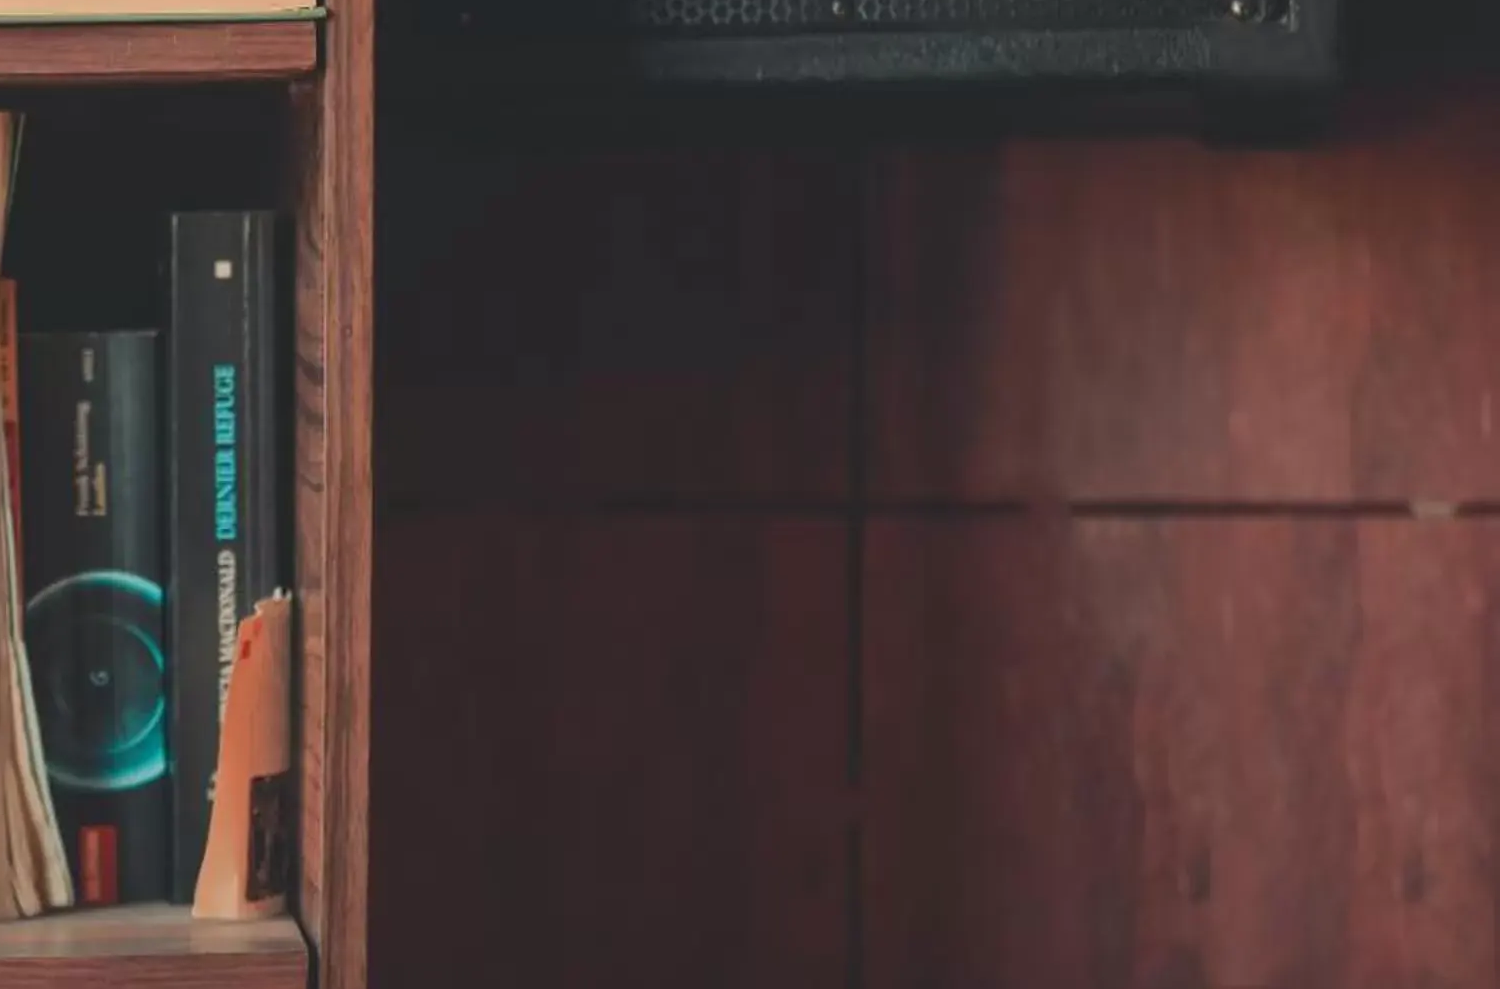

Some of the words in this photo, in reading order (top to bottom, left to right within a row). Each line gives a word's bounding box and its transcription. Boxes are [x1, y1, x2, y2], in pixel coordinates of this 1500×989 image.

[215, 364, 236, 444] REFUGE
[213, 451, 237, 541] DERNIER
[214, 550, 237, 661] MACDONALD
